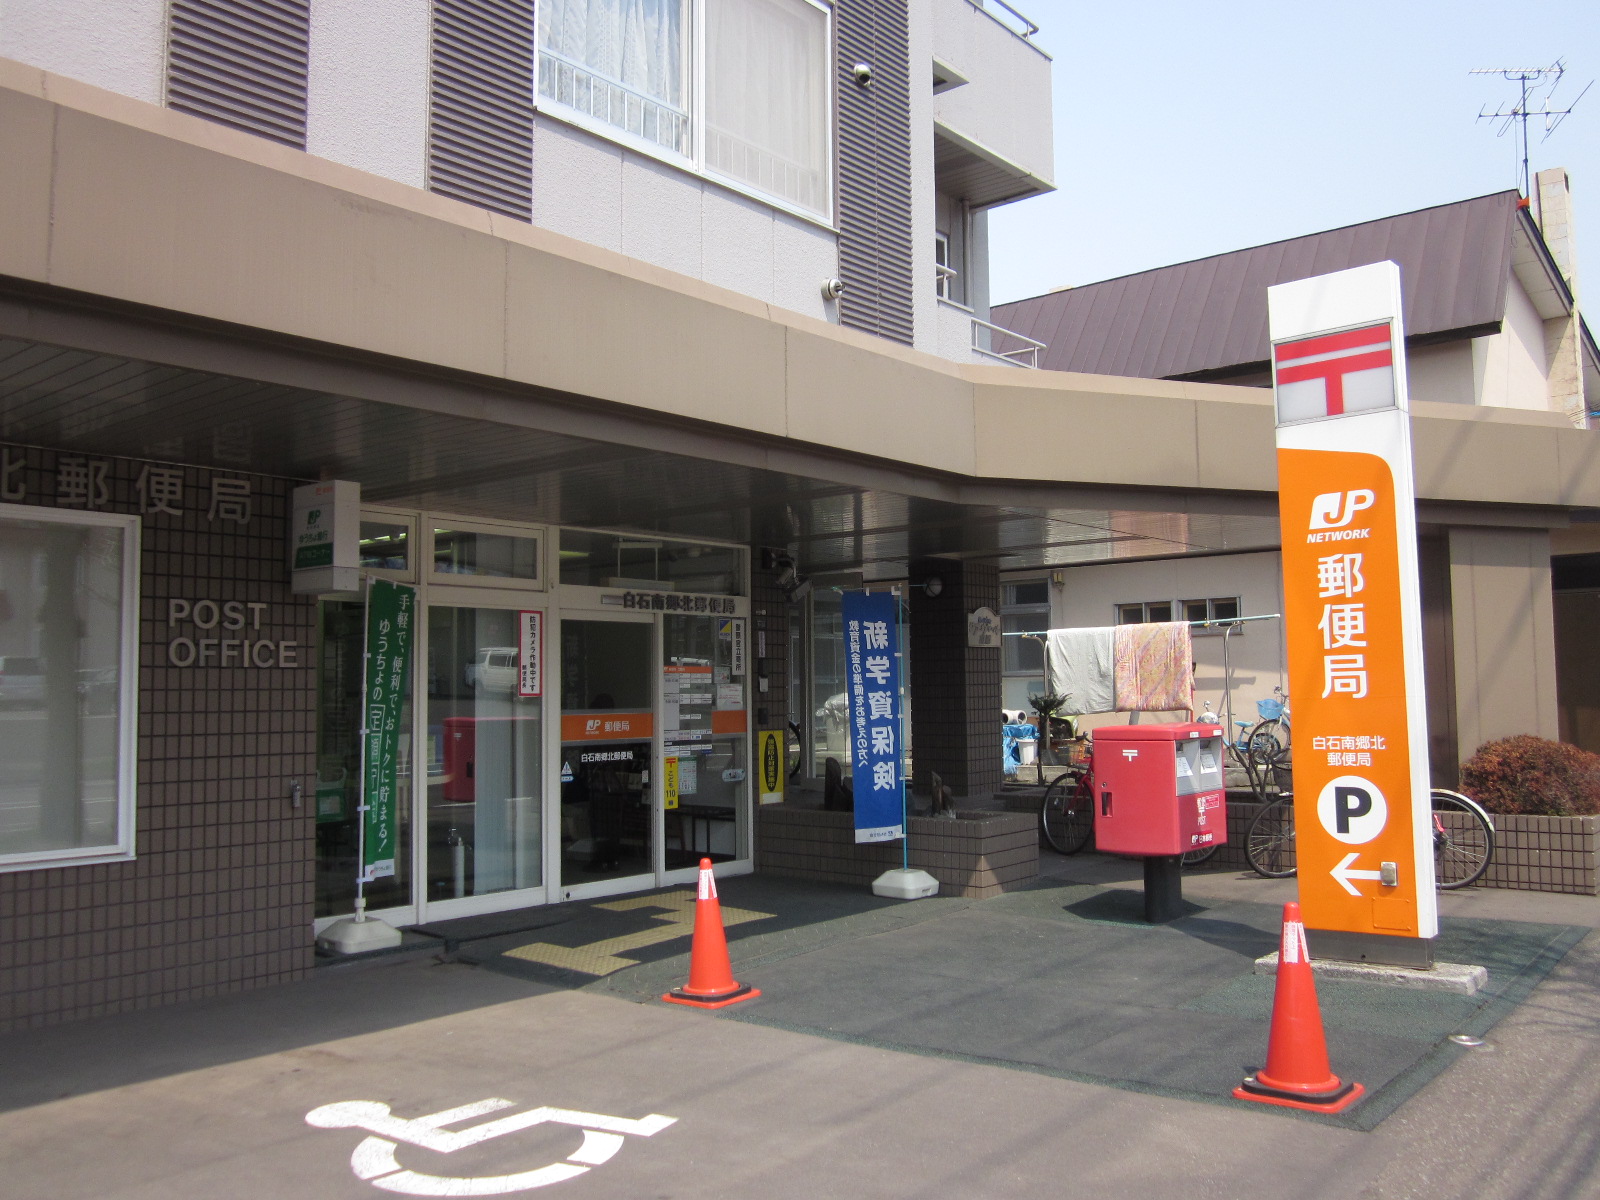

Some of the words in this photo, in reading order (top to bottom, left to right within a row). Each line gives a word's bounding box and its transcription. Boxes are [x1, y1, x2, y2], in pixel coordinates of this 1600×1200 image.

[1306, 528, 1371, 543] NETWORK
[623, 591, 736, 614] 白石南郷北郵便局
[168, 598, 267, 630] POST
[1317, 552, 1368, 699] 郵便局
[168, 637, 298, 668] OFFICE
[604, 720, 630, 732] 郵便局
[1312, 735, 1386, 750] 白石南郷北
[581, 751, 634, 763] 白石南郷北郵便局
[1327, 752, 1372, 767] 郵便局
[1334, 786, 1372, 834] P
